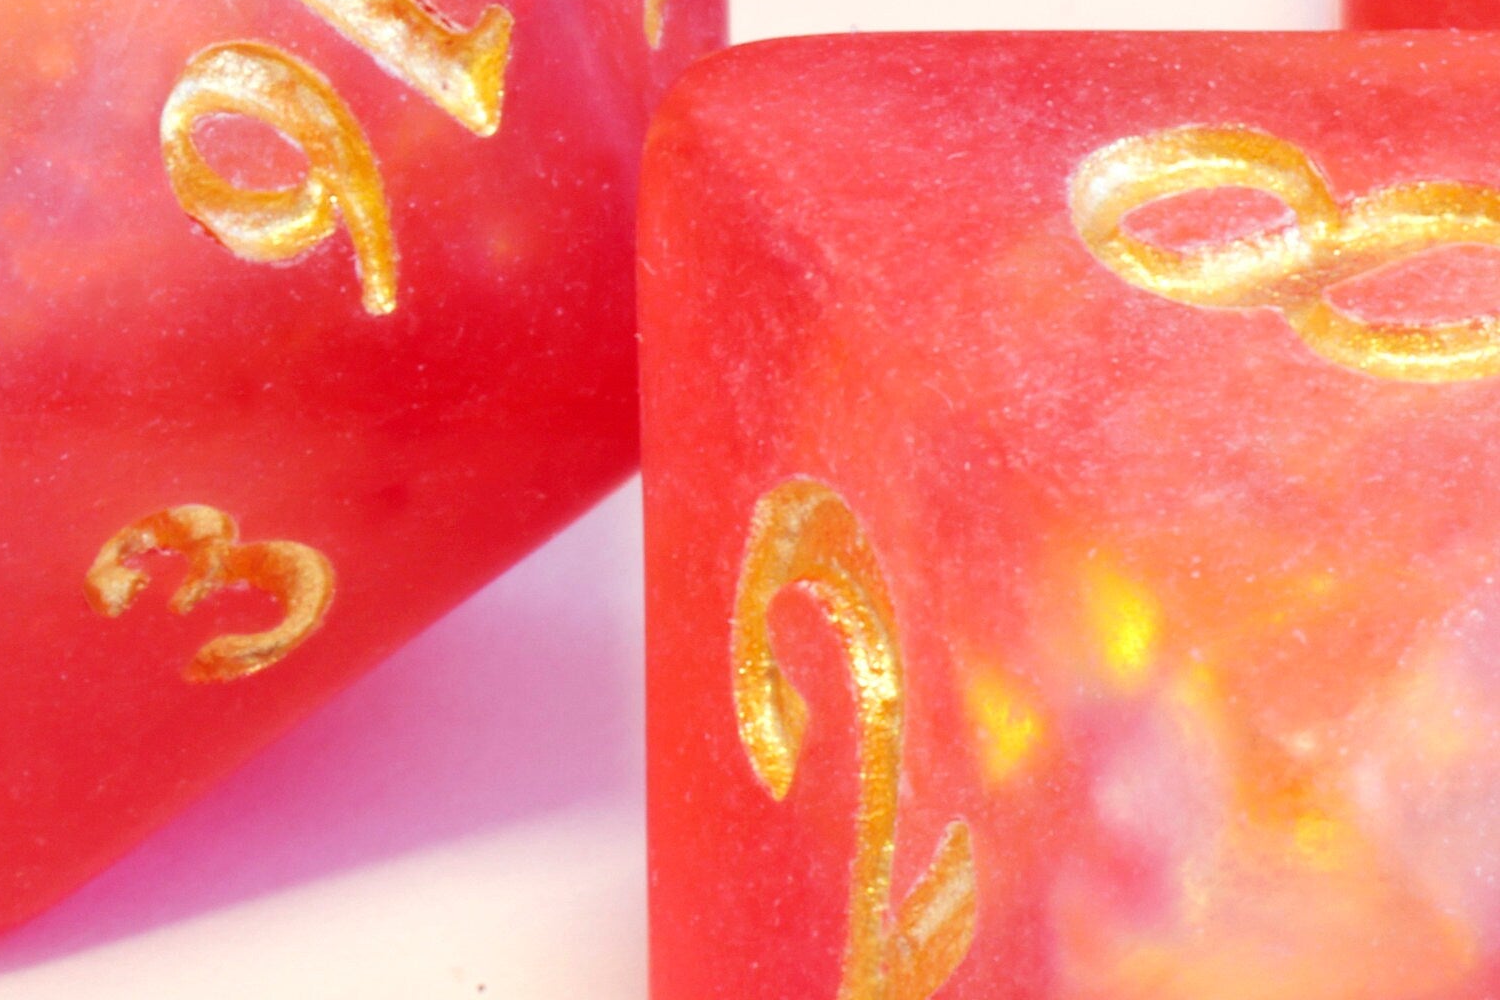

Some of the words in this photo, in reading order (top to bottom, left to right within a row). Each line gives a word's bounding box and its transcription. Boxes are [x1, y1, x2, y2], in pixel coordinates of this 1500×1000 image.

[1067, 122, 1500, 385] 8
[84, 503, 336, 684] 3
[731, 475, 980, 1000] 2
